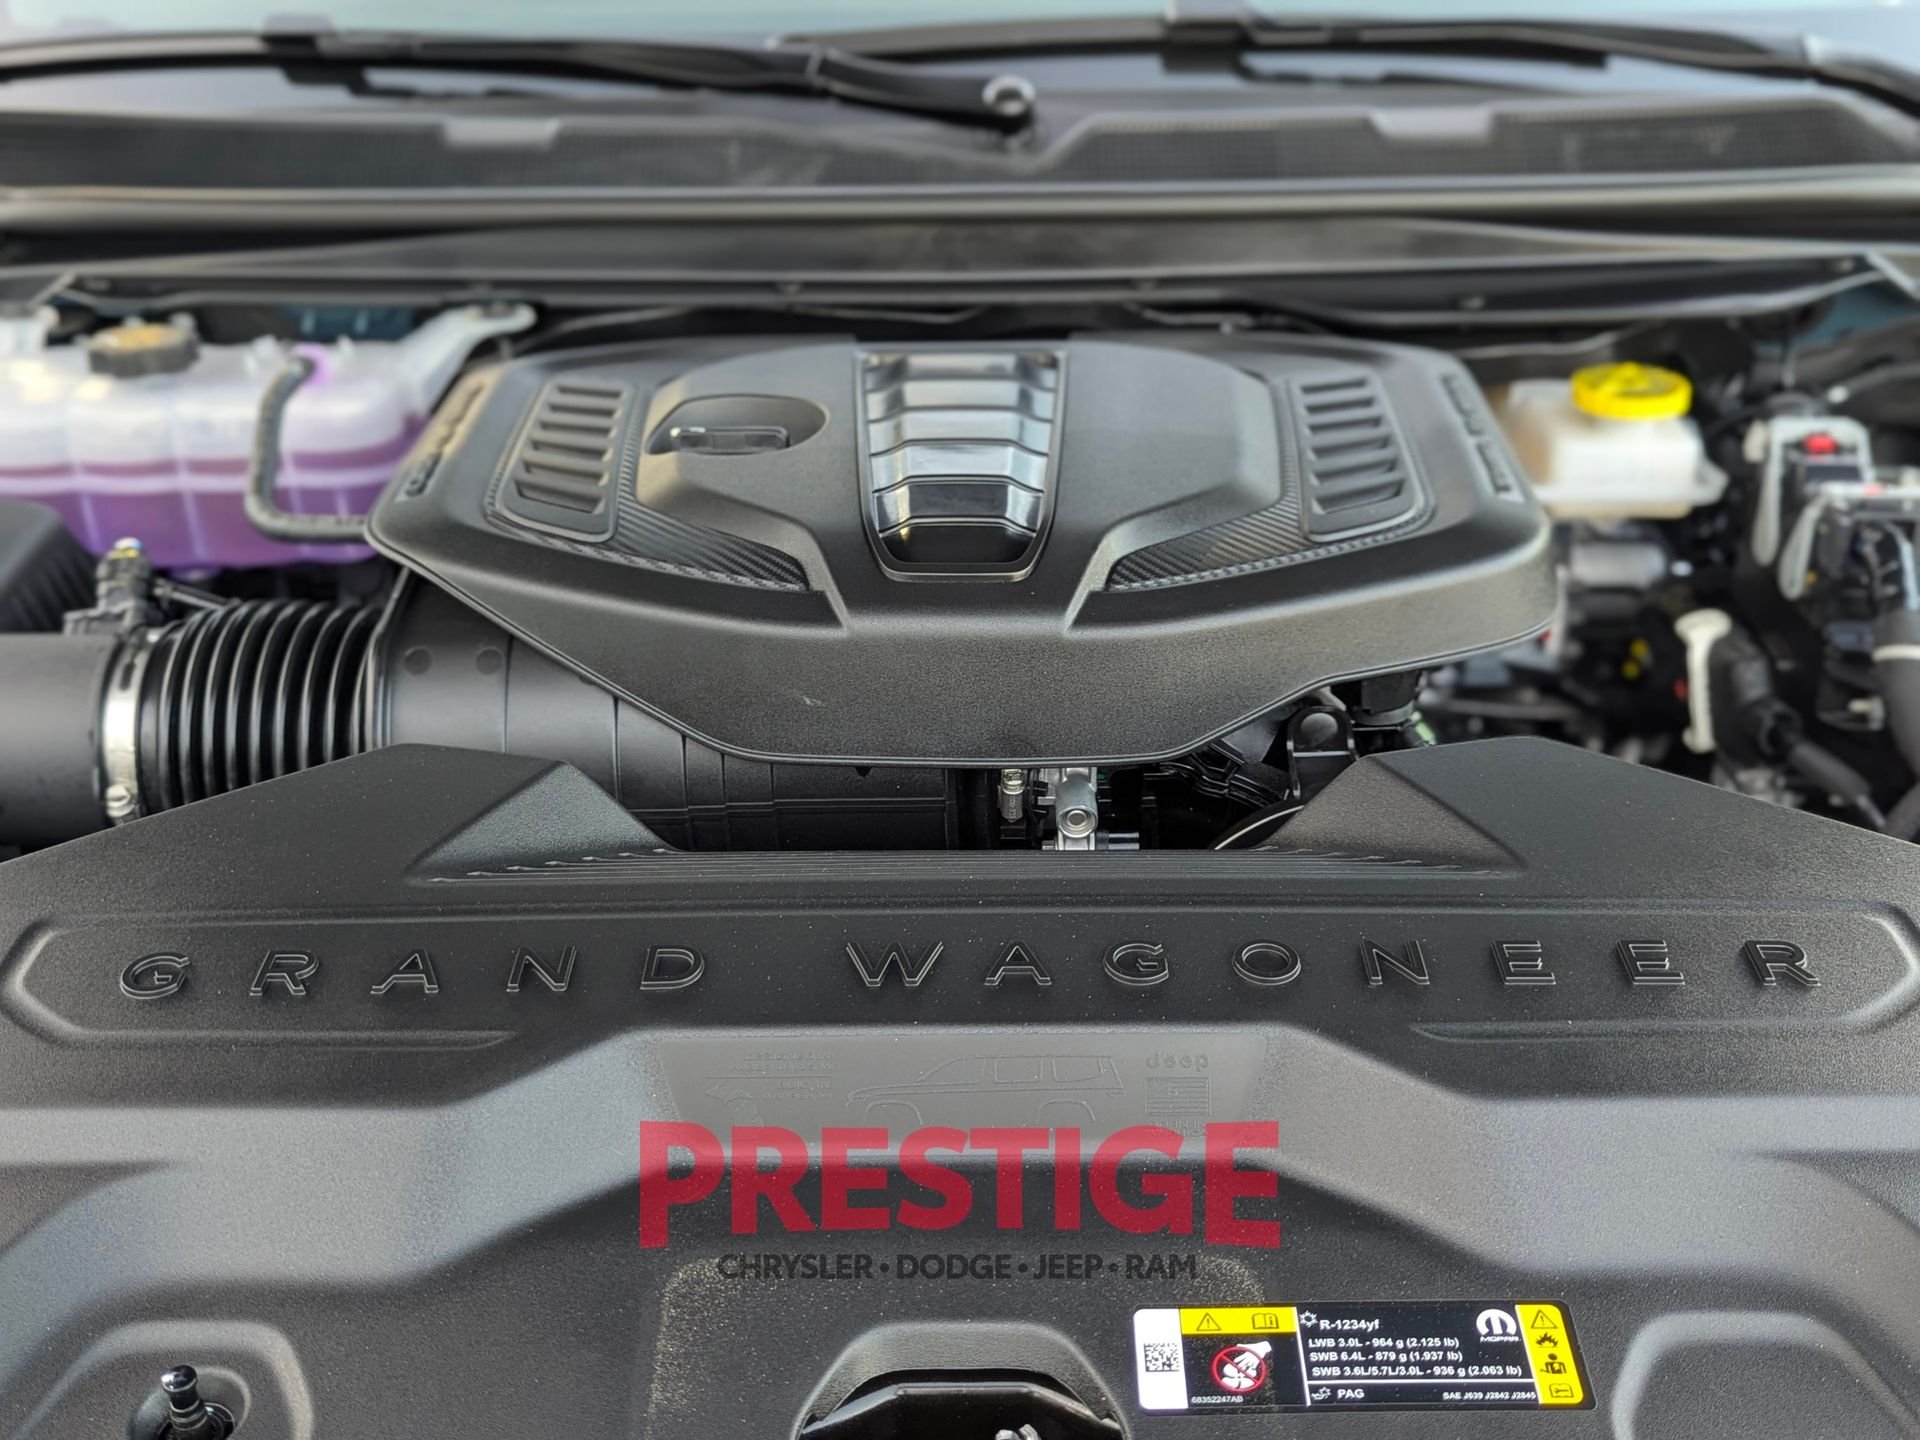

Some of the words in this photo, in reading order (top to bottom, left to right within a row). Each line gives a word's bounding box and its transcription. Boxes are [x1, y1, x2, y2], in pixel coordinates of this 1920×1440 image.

[120, 945, 706, 999] GRAND
[845, 939, 1821, 989] WAGONEER
[1319, 1319, 1380, 1331] R-1234yf
[1308, 1337, 1335, 1348] LWB
[1338, 1337, 1363, 1348] 3.0L
[1372, 1337, 1393, 1347] 964
[1396, 1339, 1404, 1349] g
[1406, 1337, 1441, 1348] (2.125
[1443, 1337, 1460, 1348] lb)
[1480, 1335, 1520, 1343] MOPAR
[1309, 1351, 1338, 1361] SWB
[1341, 1351, 1366, 1361] 6.4L
[1375, 1351, 1396, 1361] 879
[1399, 1353, 1407, 1363] g
[1409, 1350, 1444, 1362] (1.937
[1446, 1350, 1463, 1362] lb)
[1312, 1366, 1340, 1376] SWB
[1344, 1365, 1424, 1376] 3.6L/5.7L/3.0L
[1433, 1366, 1455, 1376] 936
[1457, 1367, 1465, 1377] g
[1468, 1365, 1504, 1377] (2.063
[1506, 1365, 1522, 1377] lb)
[1337, 1388, 1365, 1399] PAG
[1442, 1391, 1462, 1400] SAE
